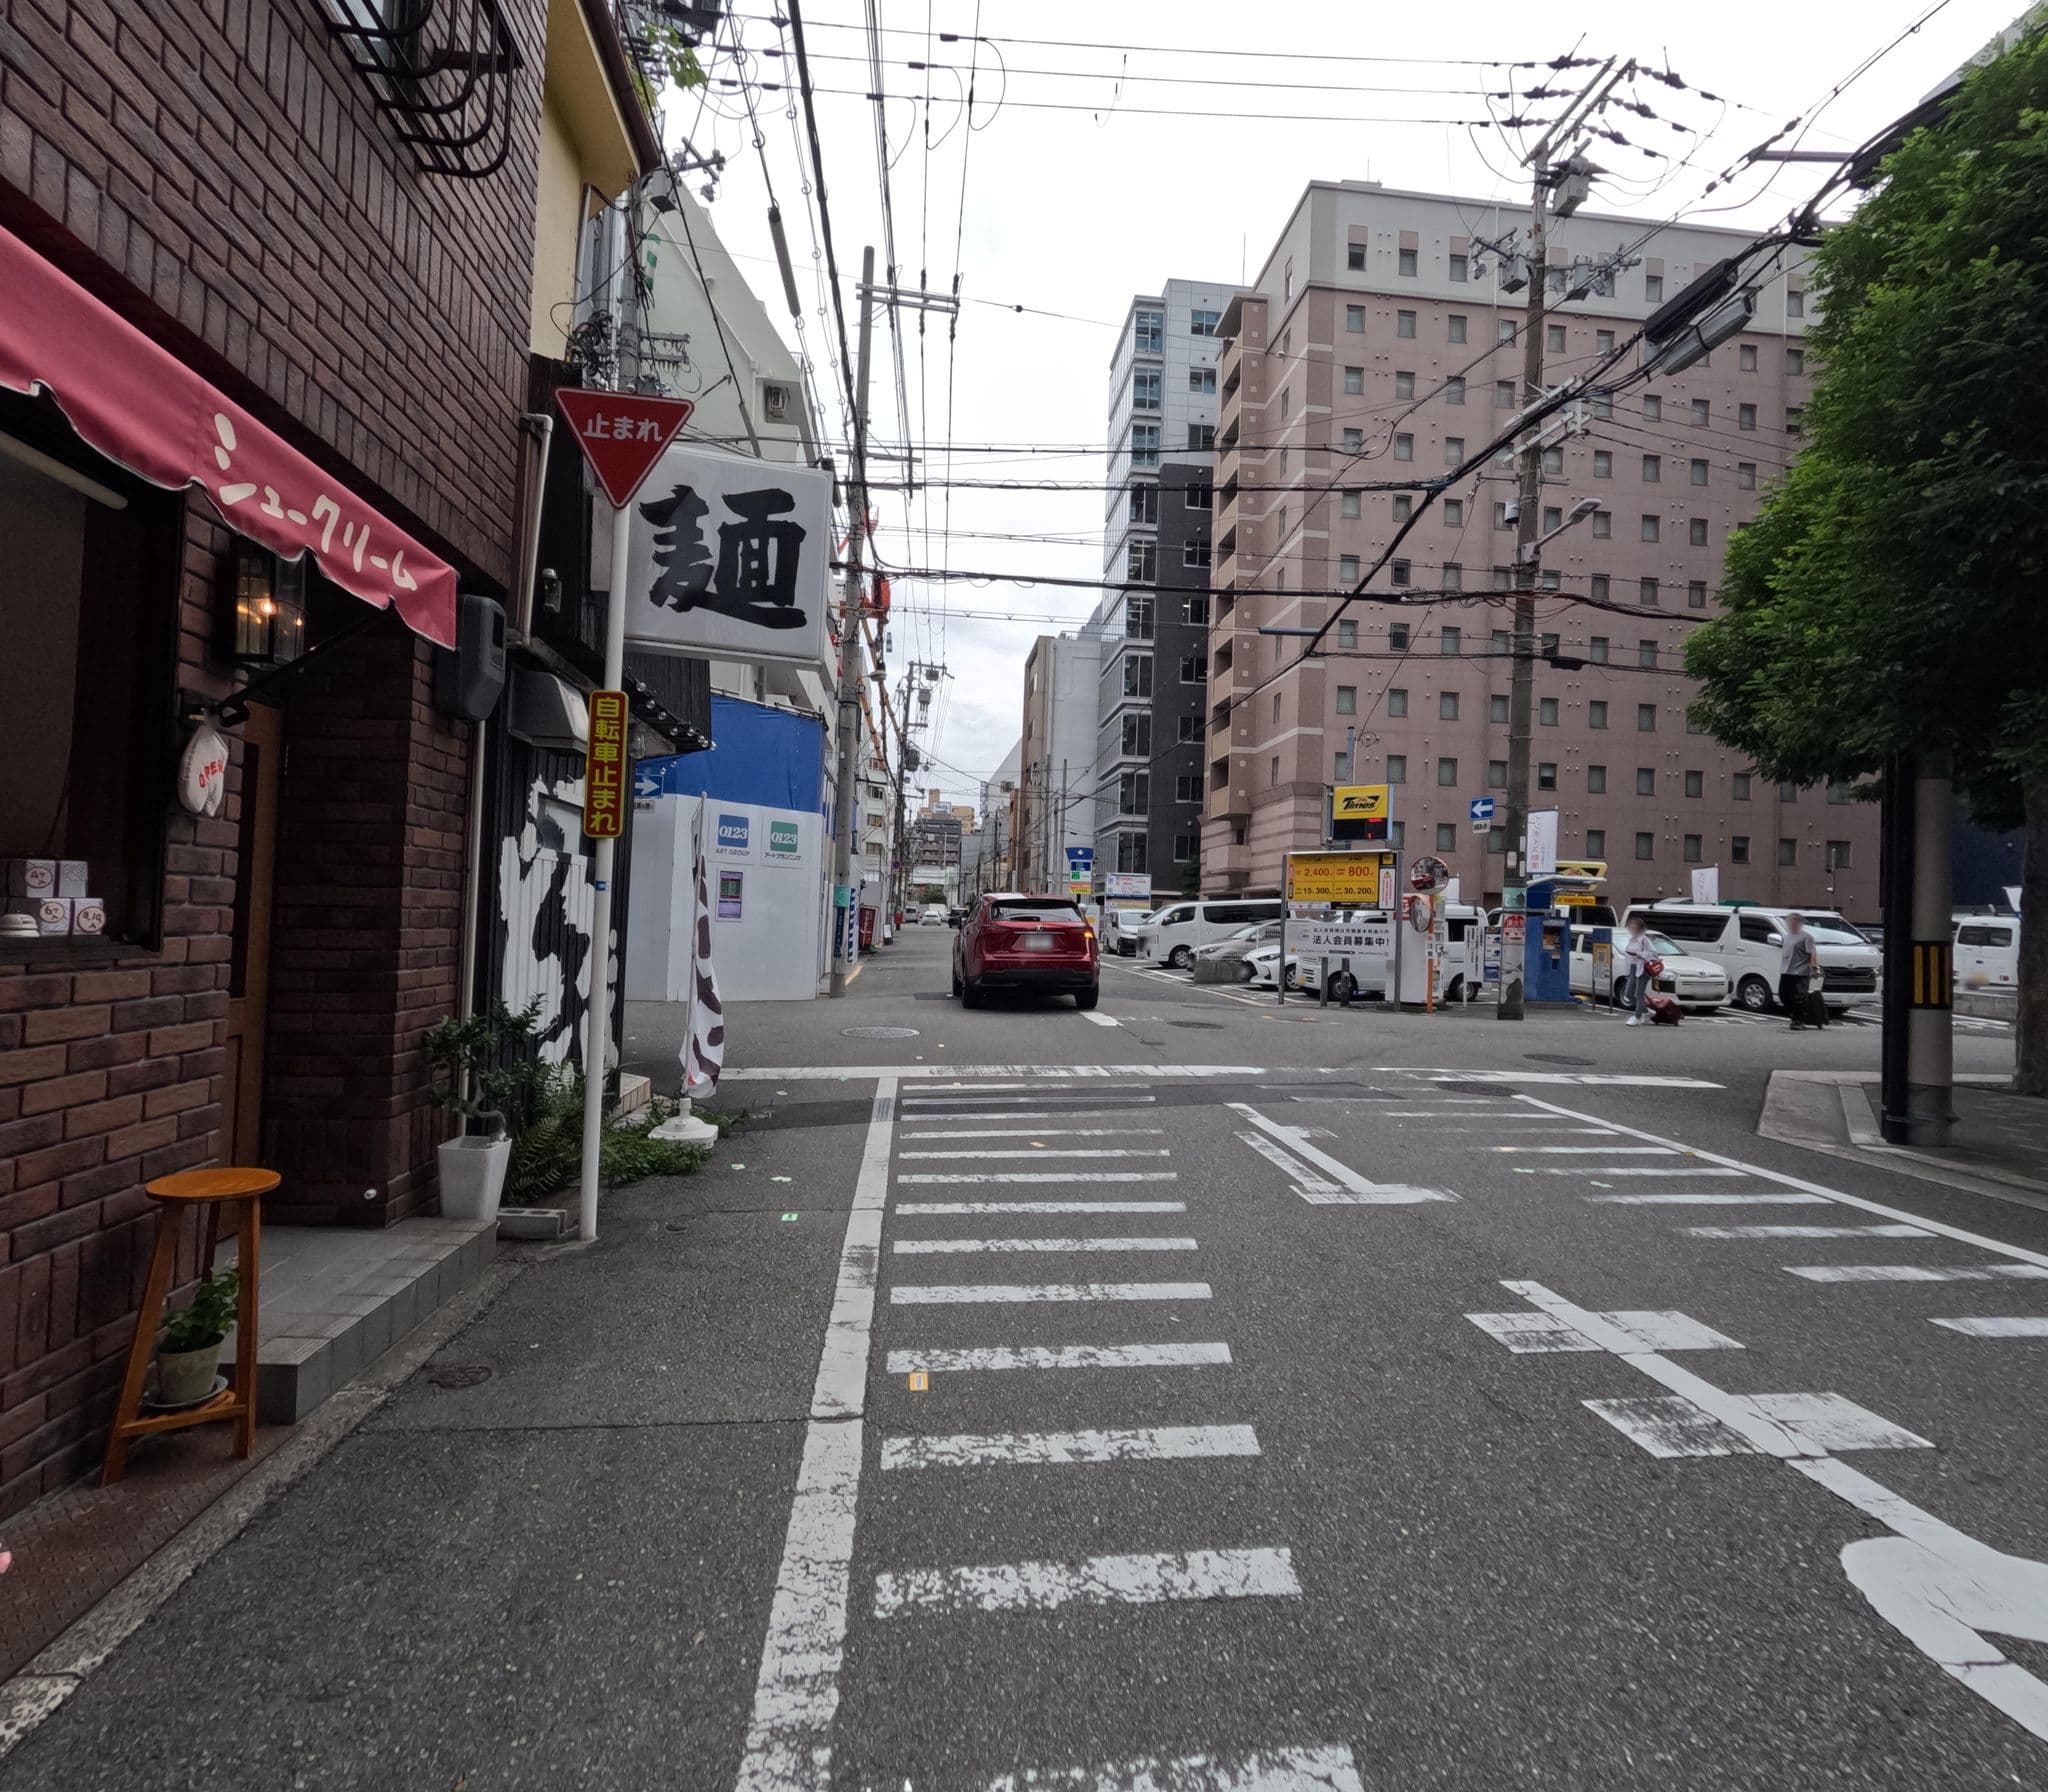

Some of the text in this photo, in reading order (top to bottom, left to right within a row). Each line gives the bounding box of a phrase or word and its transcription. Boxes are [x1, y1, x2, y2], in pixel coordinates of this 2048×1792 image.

[583, 412, 662, 442] 止まれ
[214, 413, 416, 591] シュークリーム
[639, 484, 807, 629] 麺
[199, 760, 224, 788] OPEN
[590, 697, 620, 832] 自転車止まれ
[1343, 796, 1380, 810] Times
[719, 825, 748, 840] 0123
[771, 832, 797, 845] 0123
[1348, 866, 1374, 877] 800
[1312, 935, 1390, 947] 法人会員募集中!
